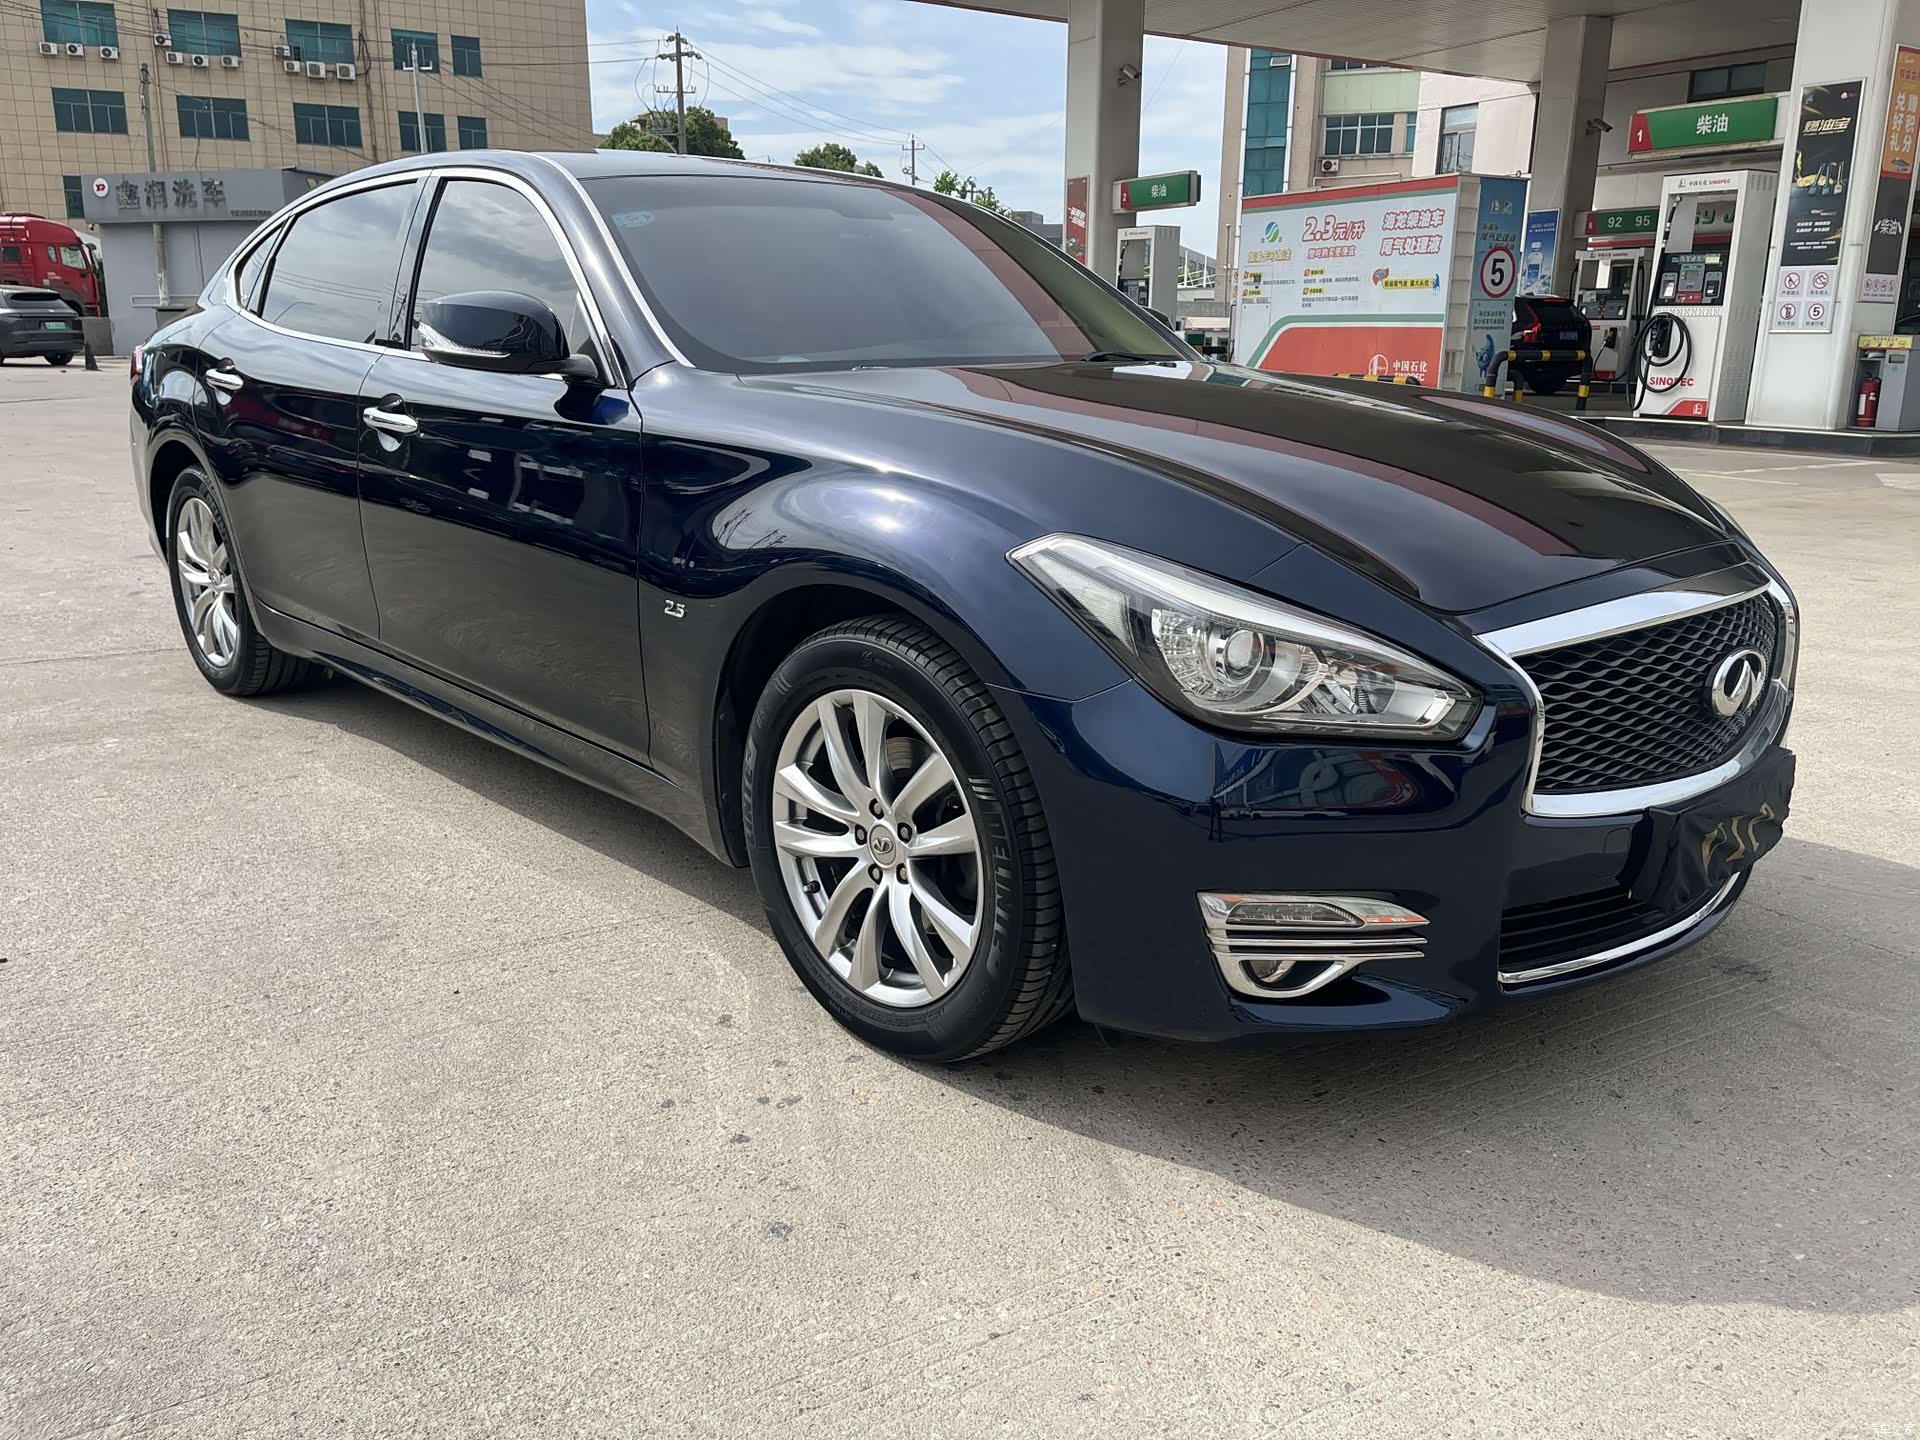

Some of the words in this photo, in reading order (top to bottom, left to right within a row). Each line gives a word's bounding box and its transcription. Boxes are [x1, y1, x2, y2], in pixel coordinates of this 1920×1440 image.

[1696, 113, 1728, 135] 柴油
[1803, 117, 1851, 133] 燃油宝
[1637, 129, 1643, 142] 1
[1122, 193, 1127, 202] 2
[1151, 184, 1167, 198] 柴油
[1302, 215, 1365, 242] 2.3元/升
[1607, 216, 1622, 228] 92
[1635, 215, 1651, 227] 95
[1879, 218, 1897, 235] 柴油
[1380, 234, 1442, 256] 尾气处理液
[1491, 258, 1505, 287] 5
[1813, 306, 1820, 317] 5
[1393, 360, 1428, 373] 中国石化
